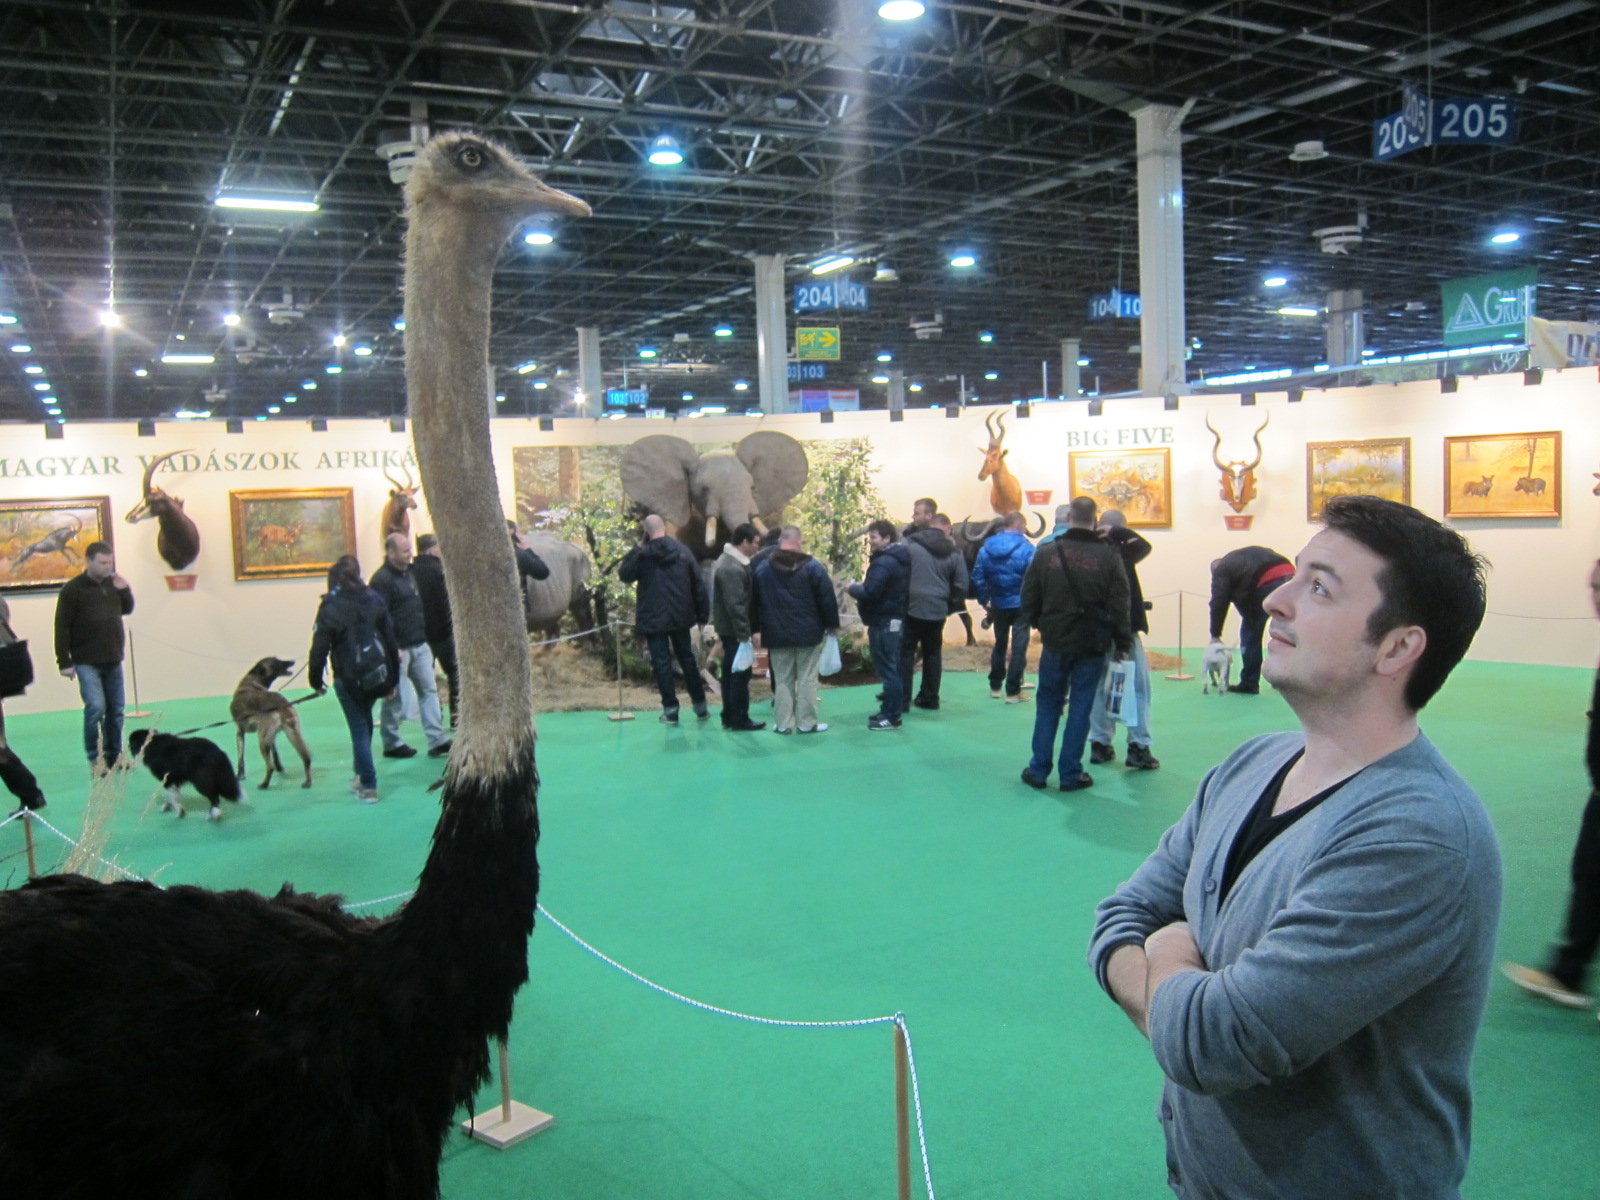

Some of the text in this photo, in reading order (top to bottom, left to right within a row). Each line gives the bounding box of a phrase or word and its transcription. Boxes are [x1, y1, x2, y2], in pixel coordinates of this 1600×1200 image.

[1440, 103, 1508, 138] 205
[798, 286, 832, 308] 204
[1124, 298, 1141, 315] 10
[802, 365, 824, 379] 103
[610, 393, 624, 404] 102
[629, 393, 646, 403] 102
[1066, 426, 1175, 447] BIG FIVE
[136, 449, 302, 473] VADÁSZOK
